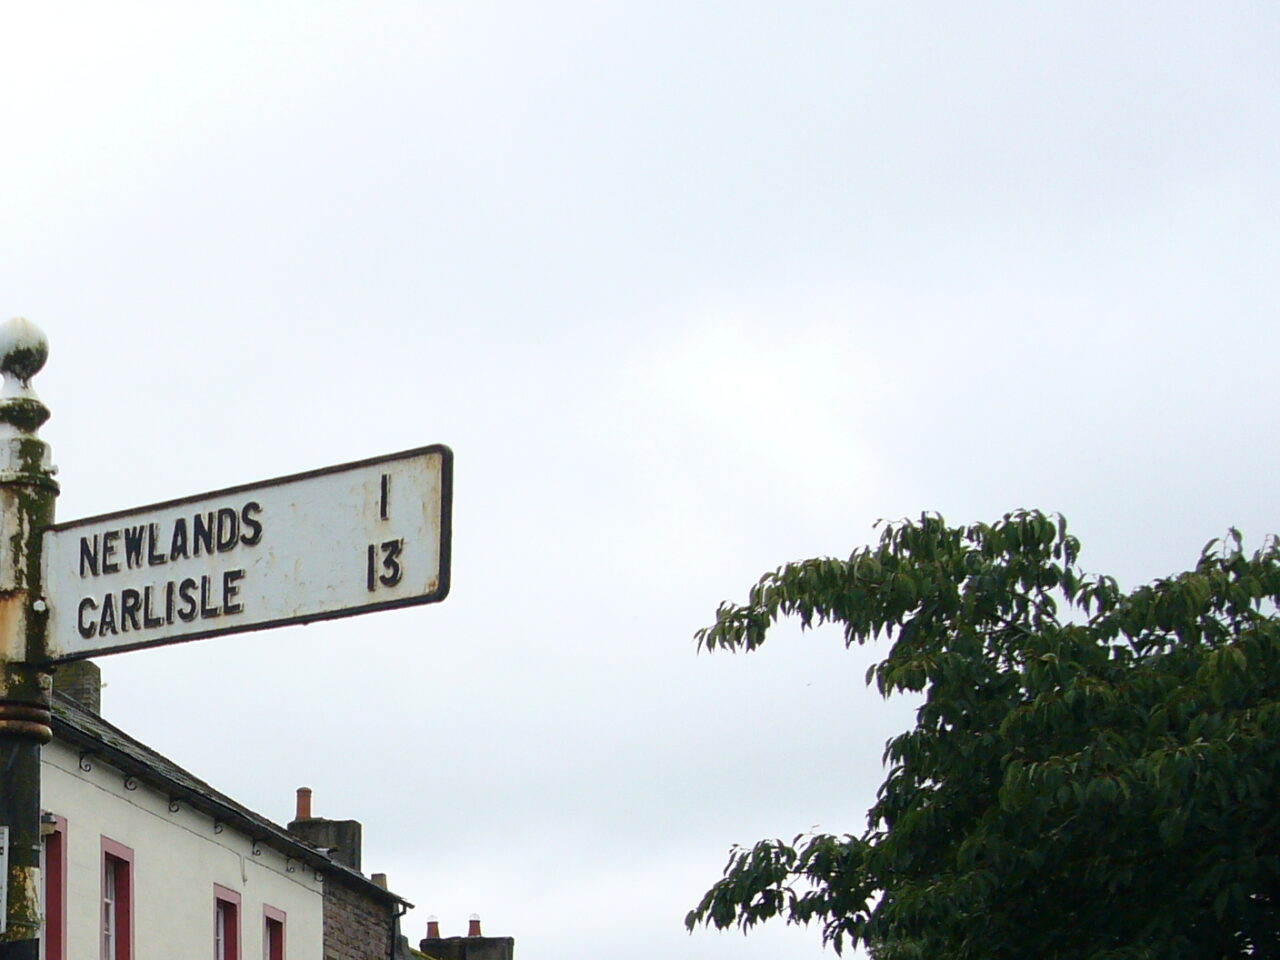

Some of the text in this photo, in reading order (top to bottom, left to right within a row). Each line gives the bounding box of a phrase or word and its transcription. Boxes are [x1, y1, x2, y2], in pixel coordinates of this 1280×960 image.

[79, 500, 264, 578] NEWLANDS
[76, 537, 405, 639] CARLISLE 13
